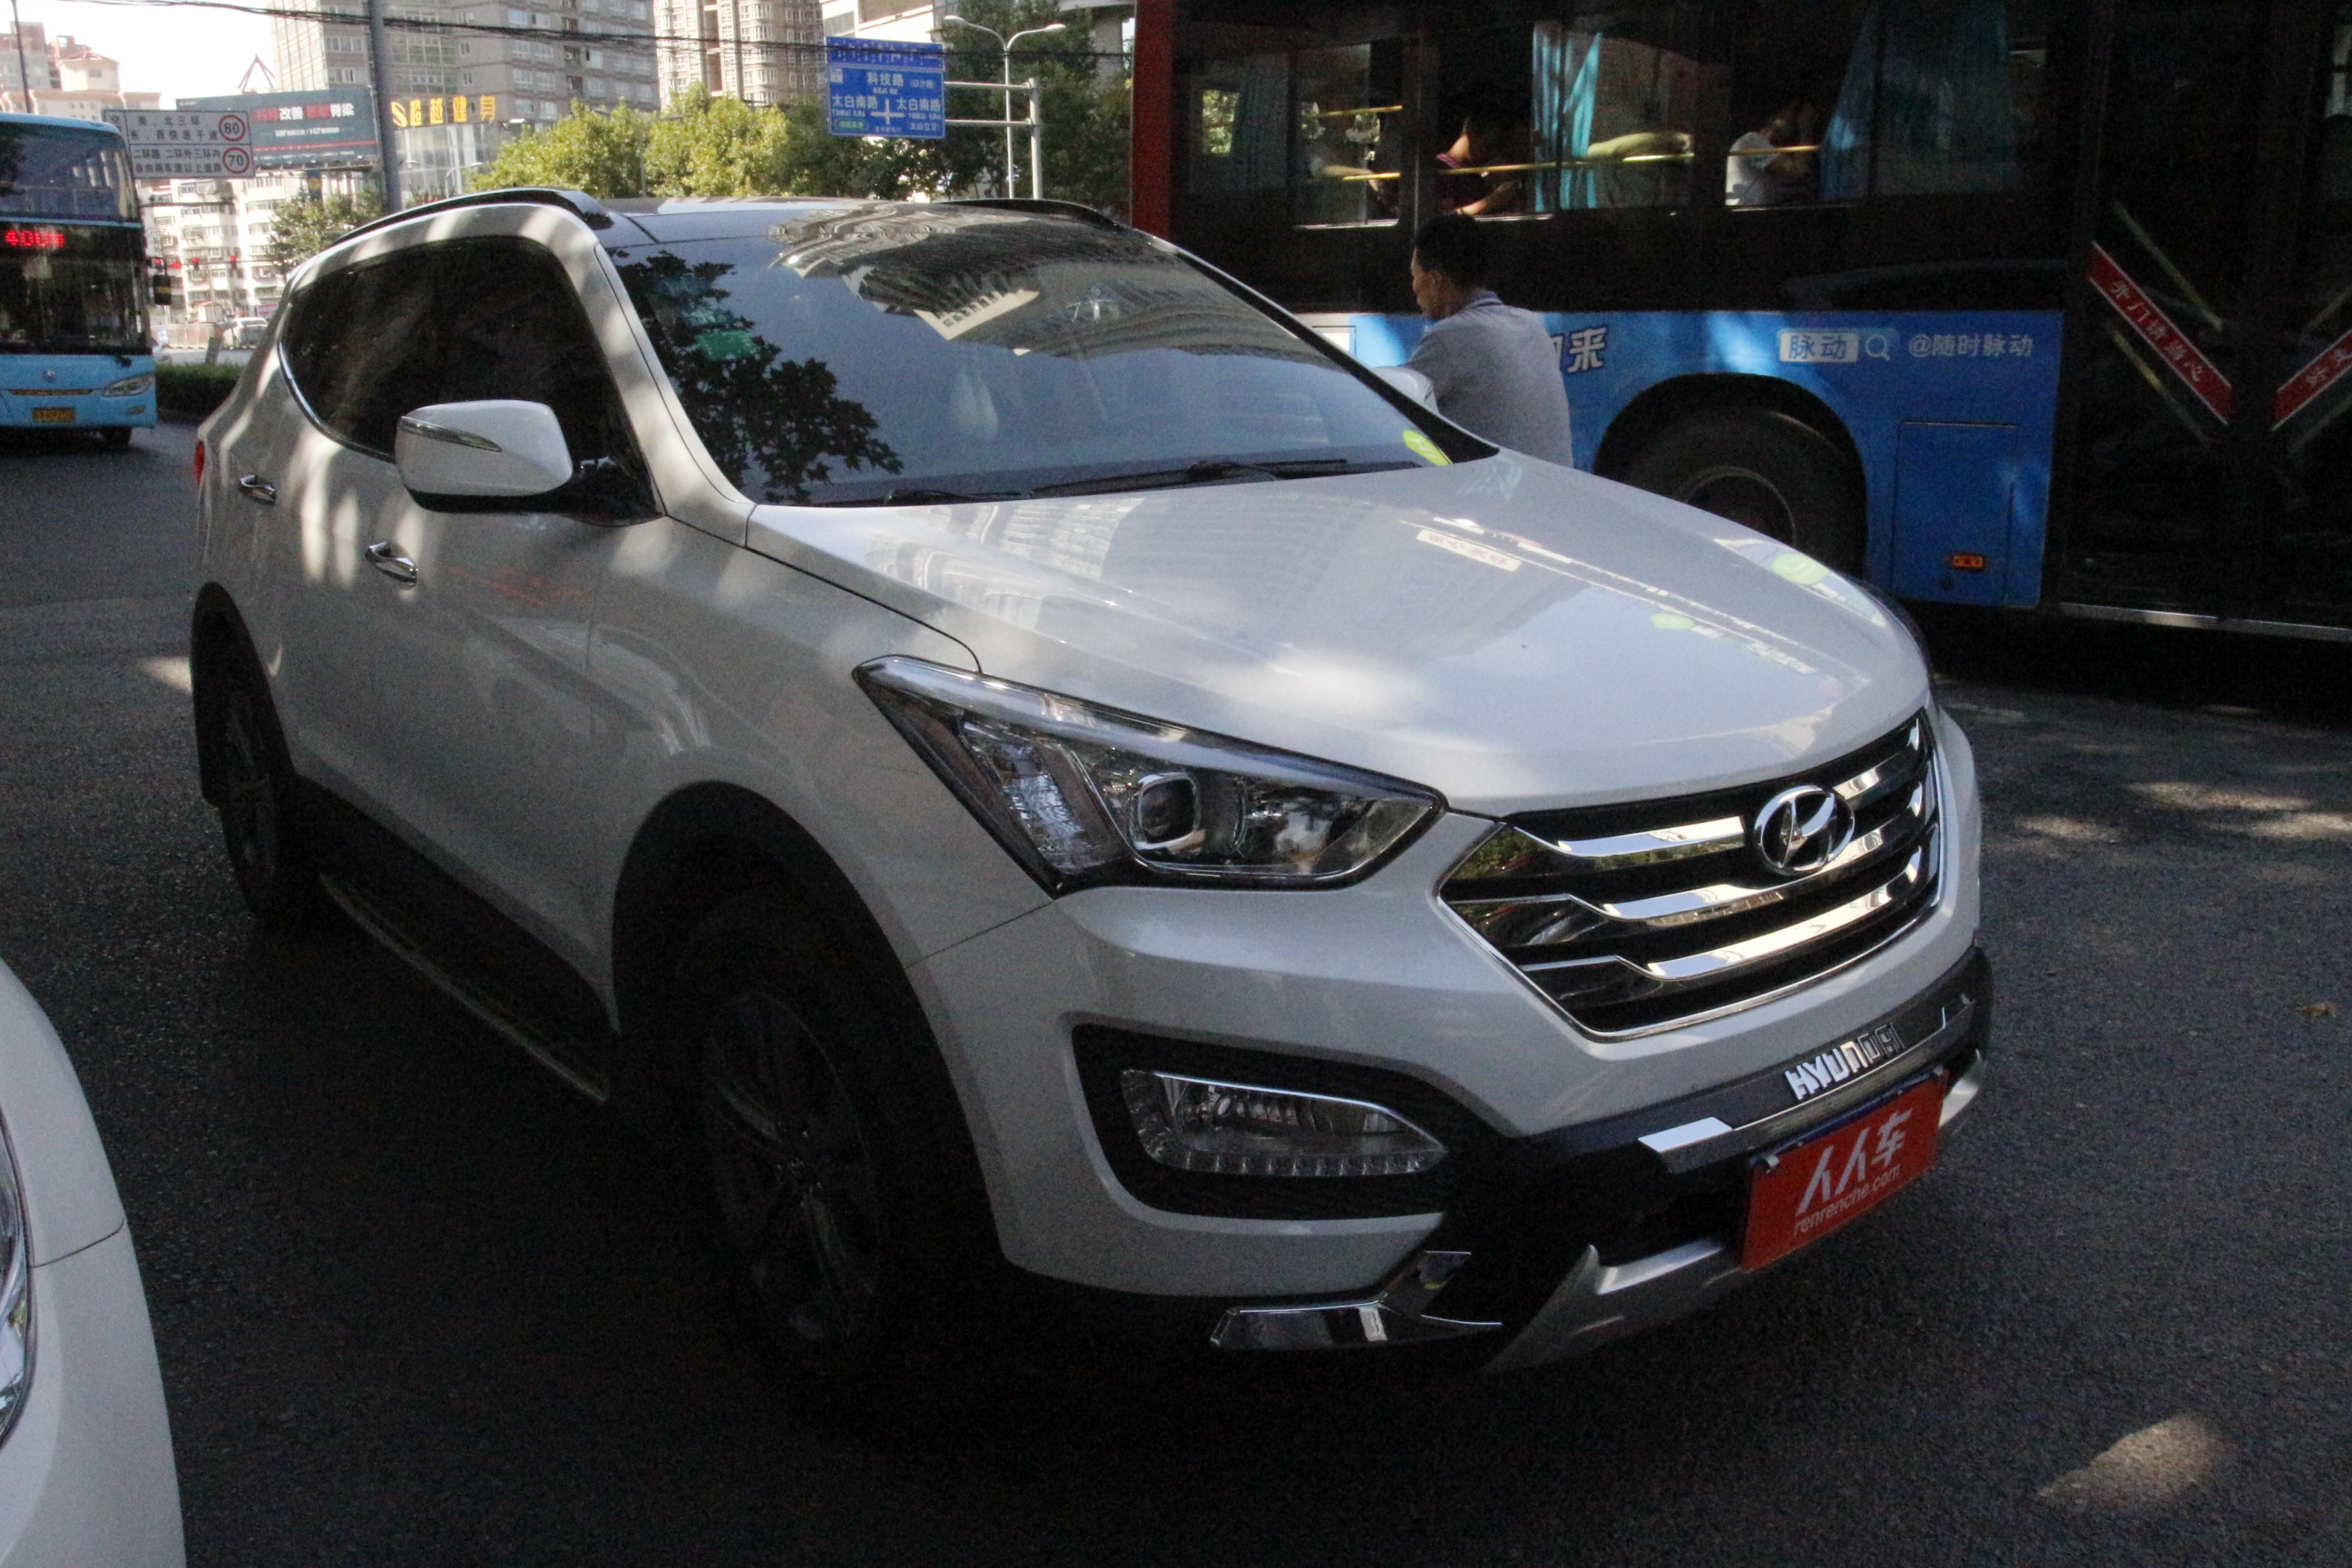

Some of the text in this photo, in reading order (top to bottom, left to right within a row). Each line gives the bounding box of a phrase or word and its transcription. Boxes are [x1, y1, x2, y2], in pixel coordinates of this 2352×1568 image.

[867, 72, 904, 86] 科技路
[410, 94, 495, 126] 超越健身
[832, 94, 877, 109] 太白南路
[897, 97, 941, 112] 太白南路
[224, 122, 240, 134] 80
[229, 155, 244, 166] 70
[1788, 332, 1847, 360] 脉动
[1908, 332, 2034, 360] @随时脉动
[1784, 1022, 1905, 1101] HYUNDAI
[1795, 1108, 1913, 1218] 人人车
[1794, 1164, 1901, 1237] renrenche.com
